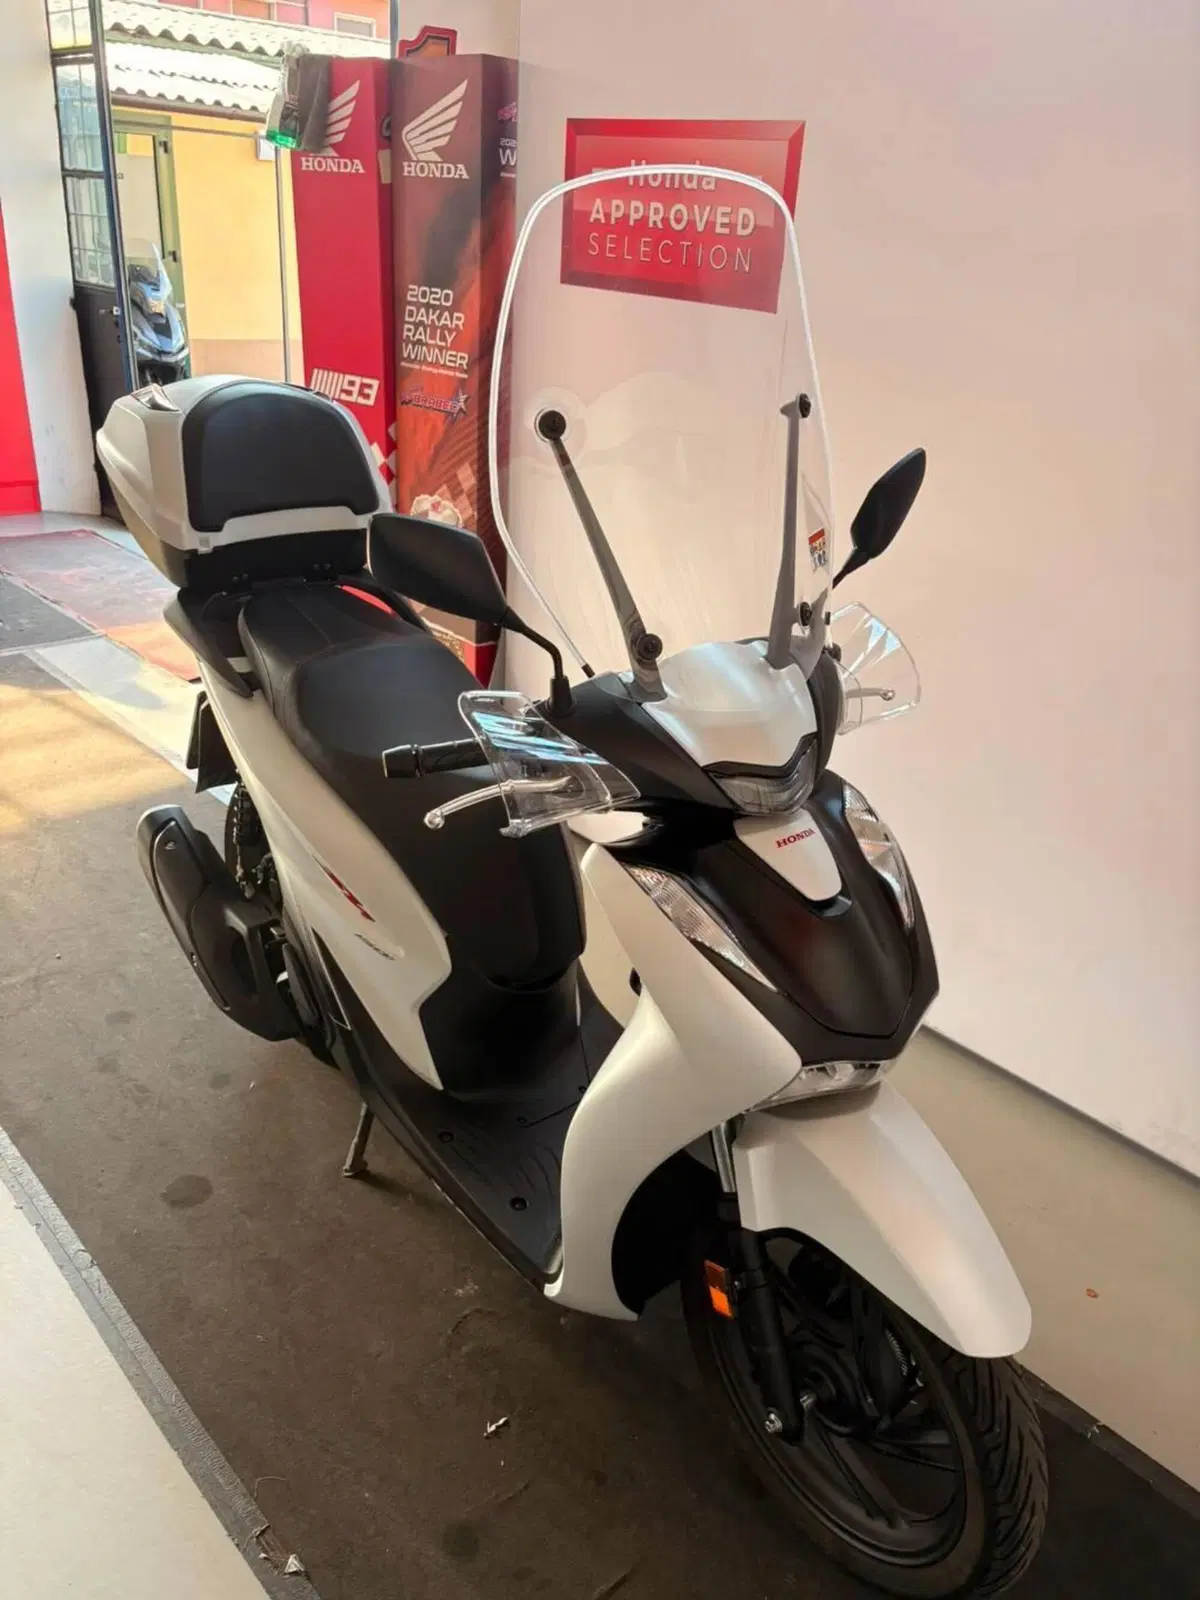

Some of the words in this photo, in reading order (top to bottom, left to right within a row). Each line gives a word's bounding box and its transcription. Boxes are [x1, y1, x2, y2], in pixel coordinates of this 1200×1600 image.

[300, 157, 366, 174] HONDA
[402, 161, 470, 180] HONDA
[589, 198, 756, 236] APPROVED
[588, 232, 753, 273] SELECTION
[406, 284, 453, 306] 2020
[404, 306, 465, 330] DAKAR
[403, 324, 457, 347] RALLY
[402, 342, 469, 369] WINNER
[776, 828, 816, 848] HONDA
